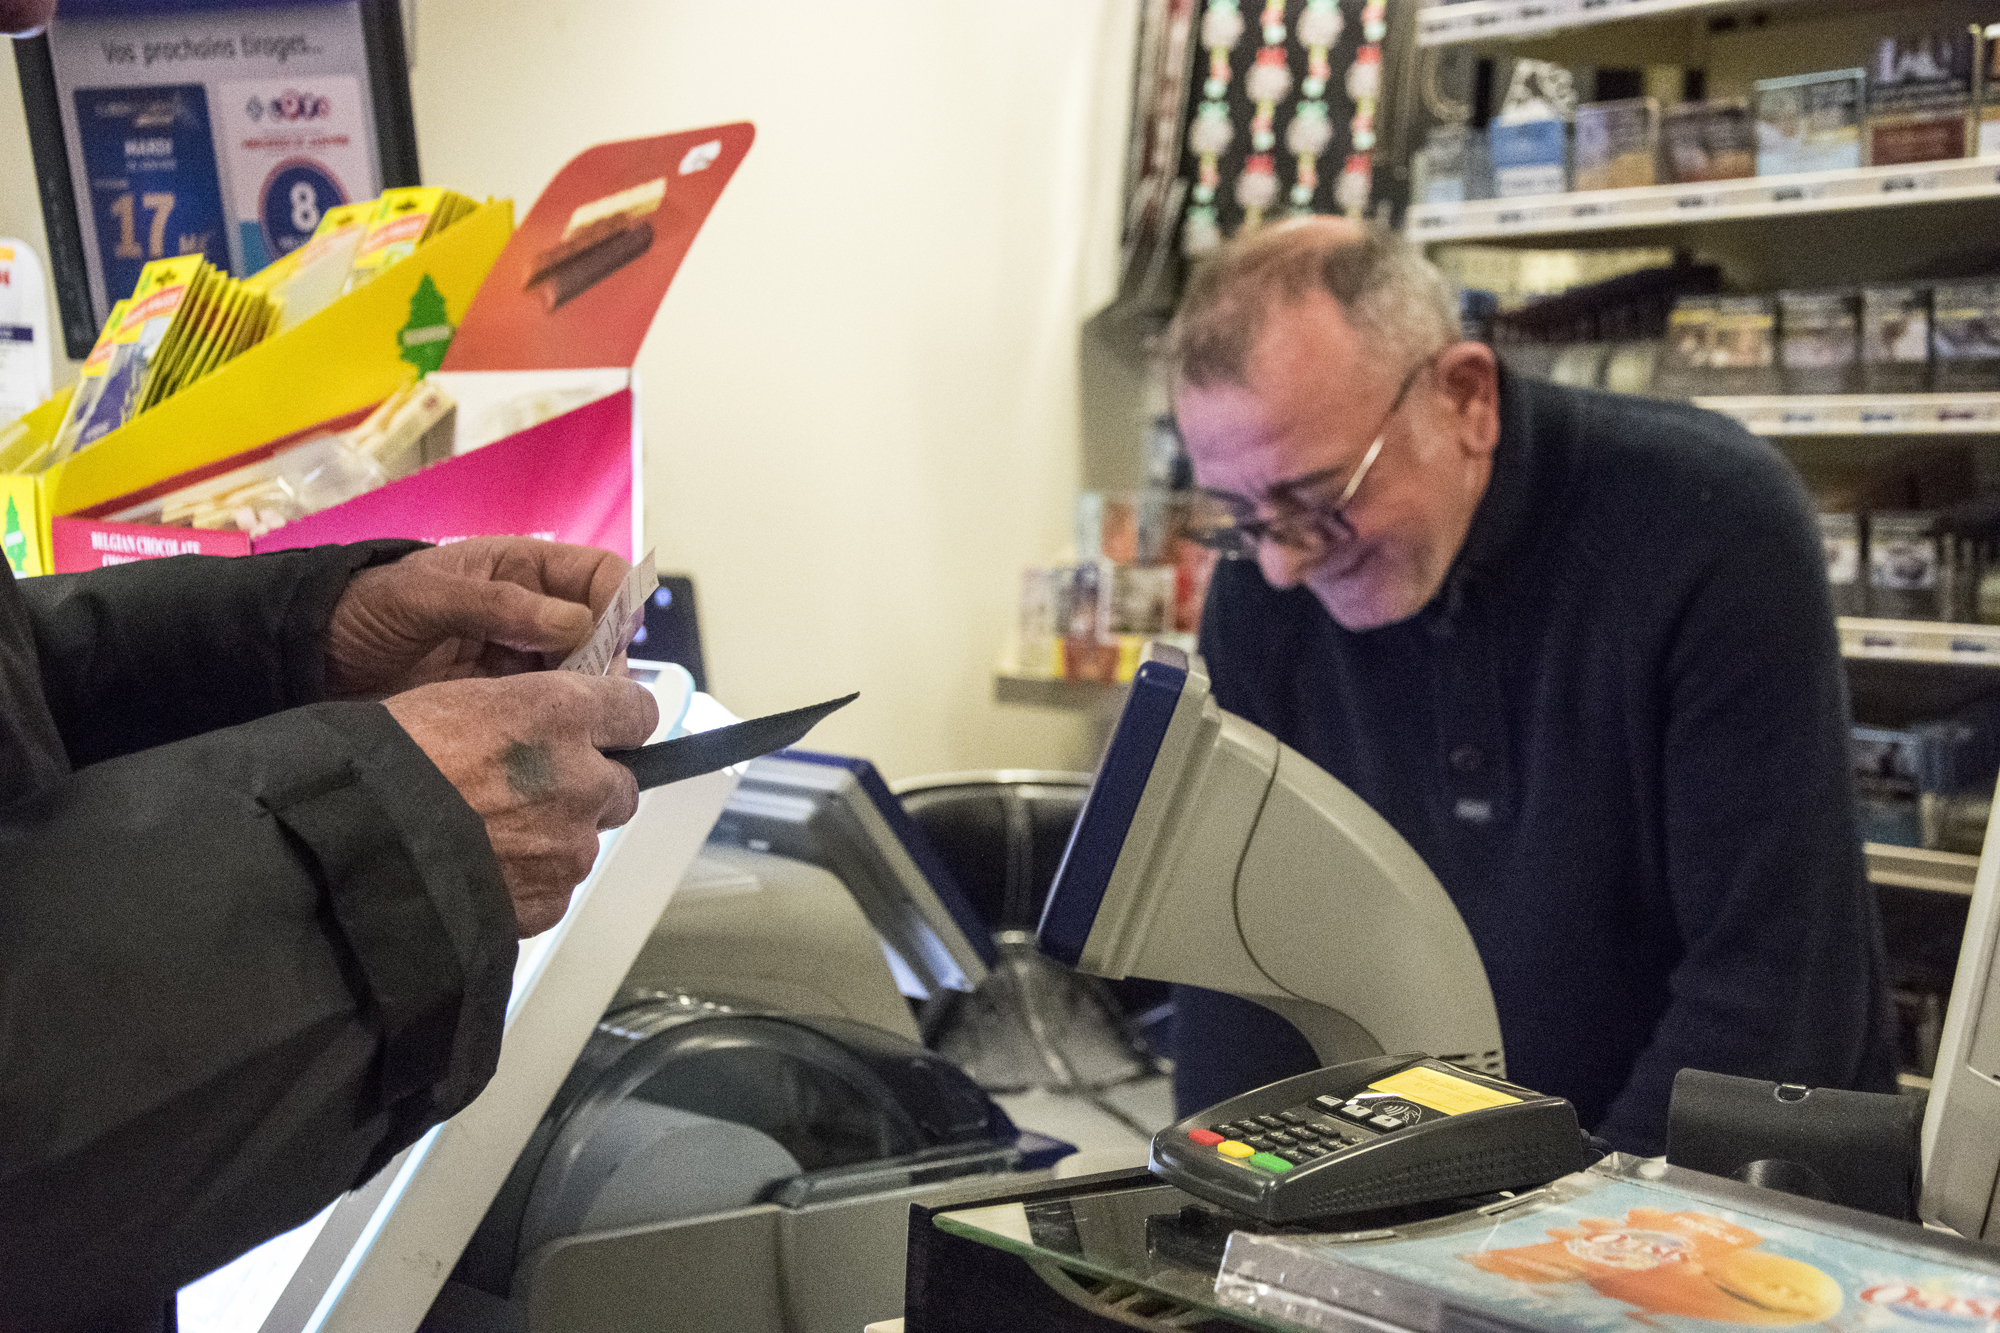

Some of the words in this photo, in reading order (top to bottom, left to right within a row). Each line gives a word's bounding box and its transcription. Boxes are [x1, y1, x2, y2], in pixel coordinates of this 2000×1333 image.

[100, 41, 135, 64] Vos
[143, 37, 236, 65] prochains
[111, 193, 175, 261] 17
[289, 181, 320, 234] 8
[91, 531, 136, 553] BELGIAN
[136, 535, 200, 558] CHOCOLATE
